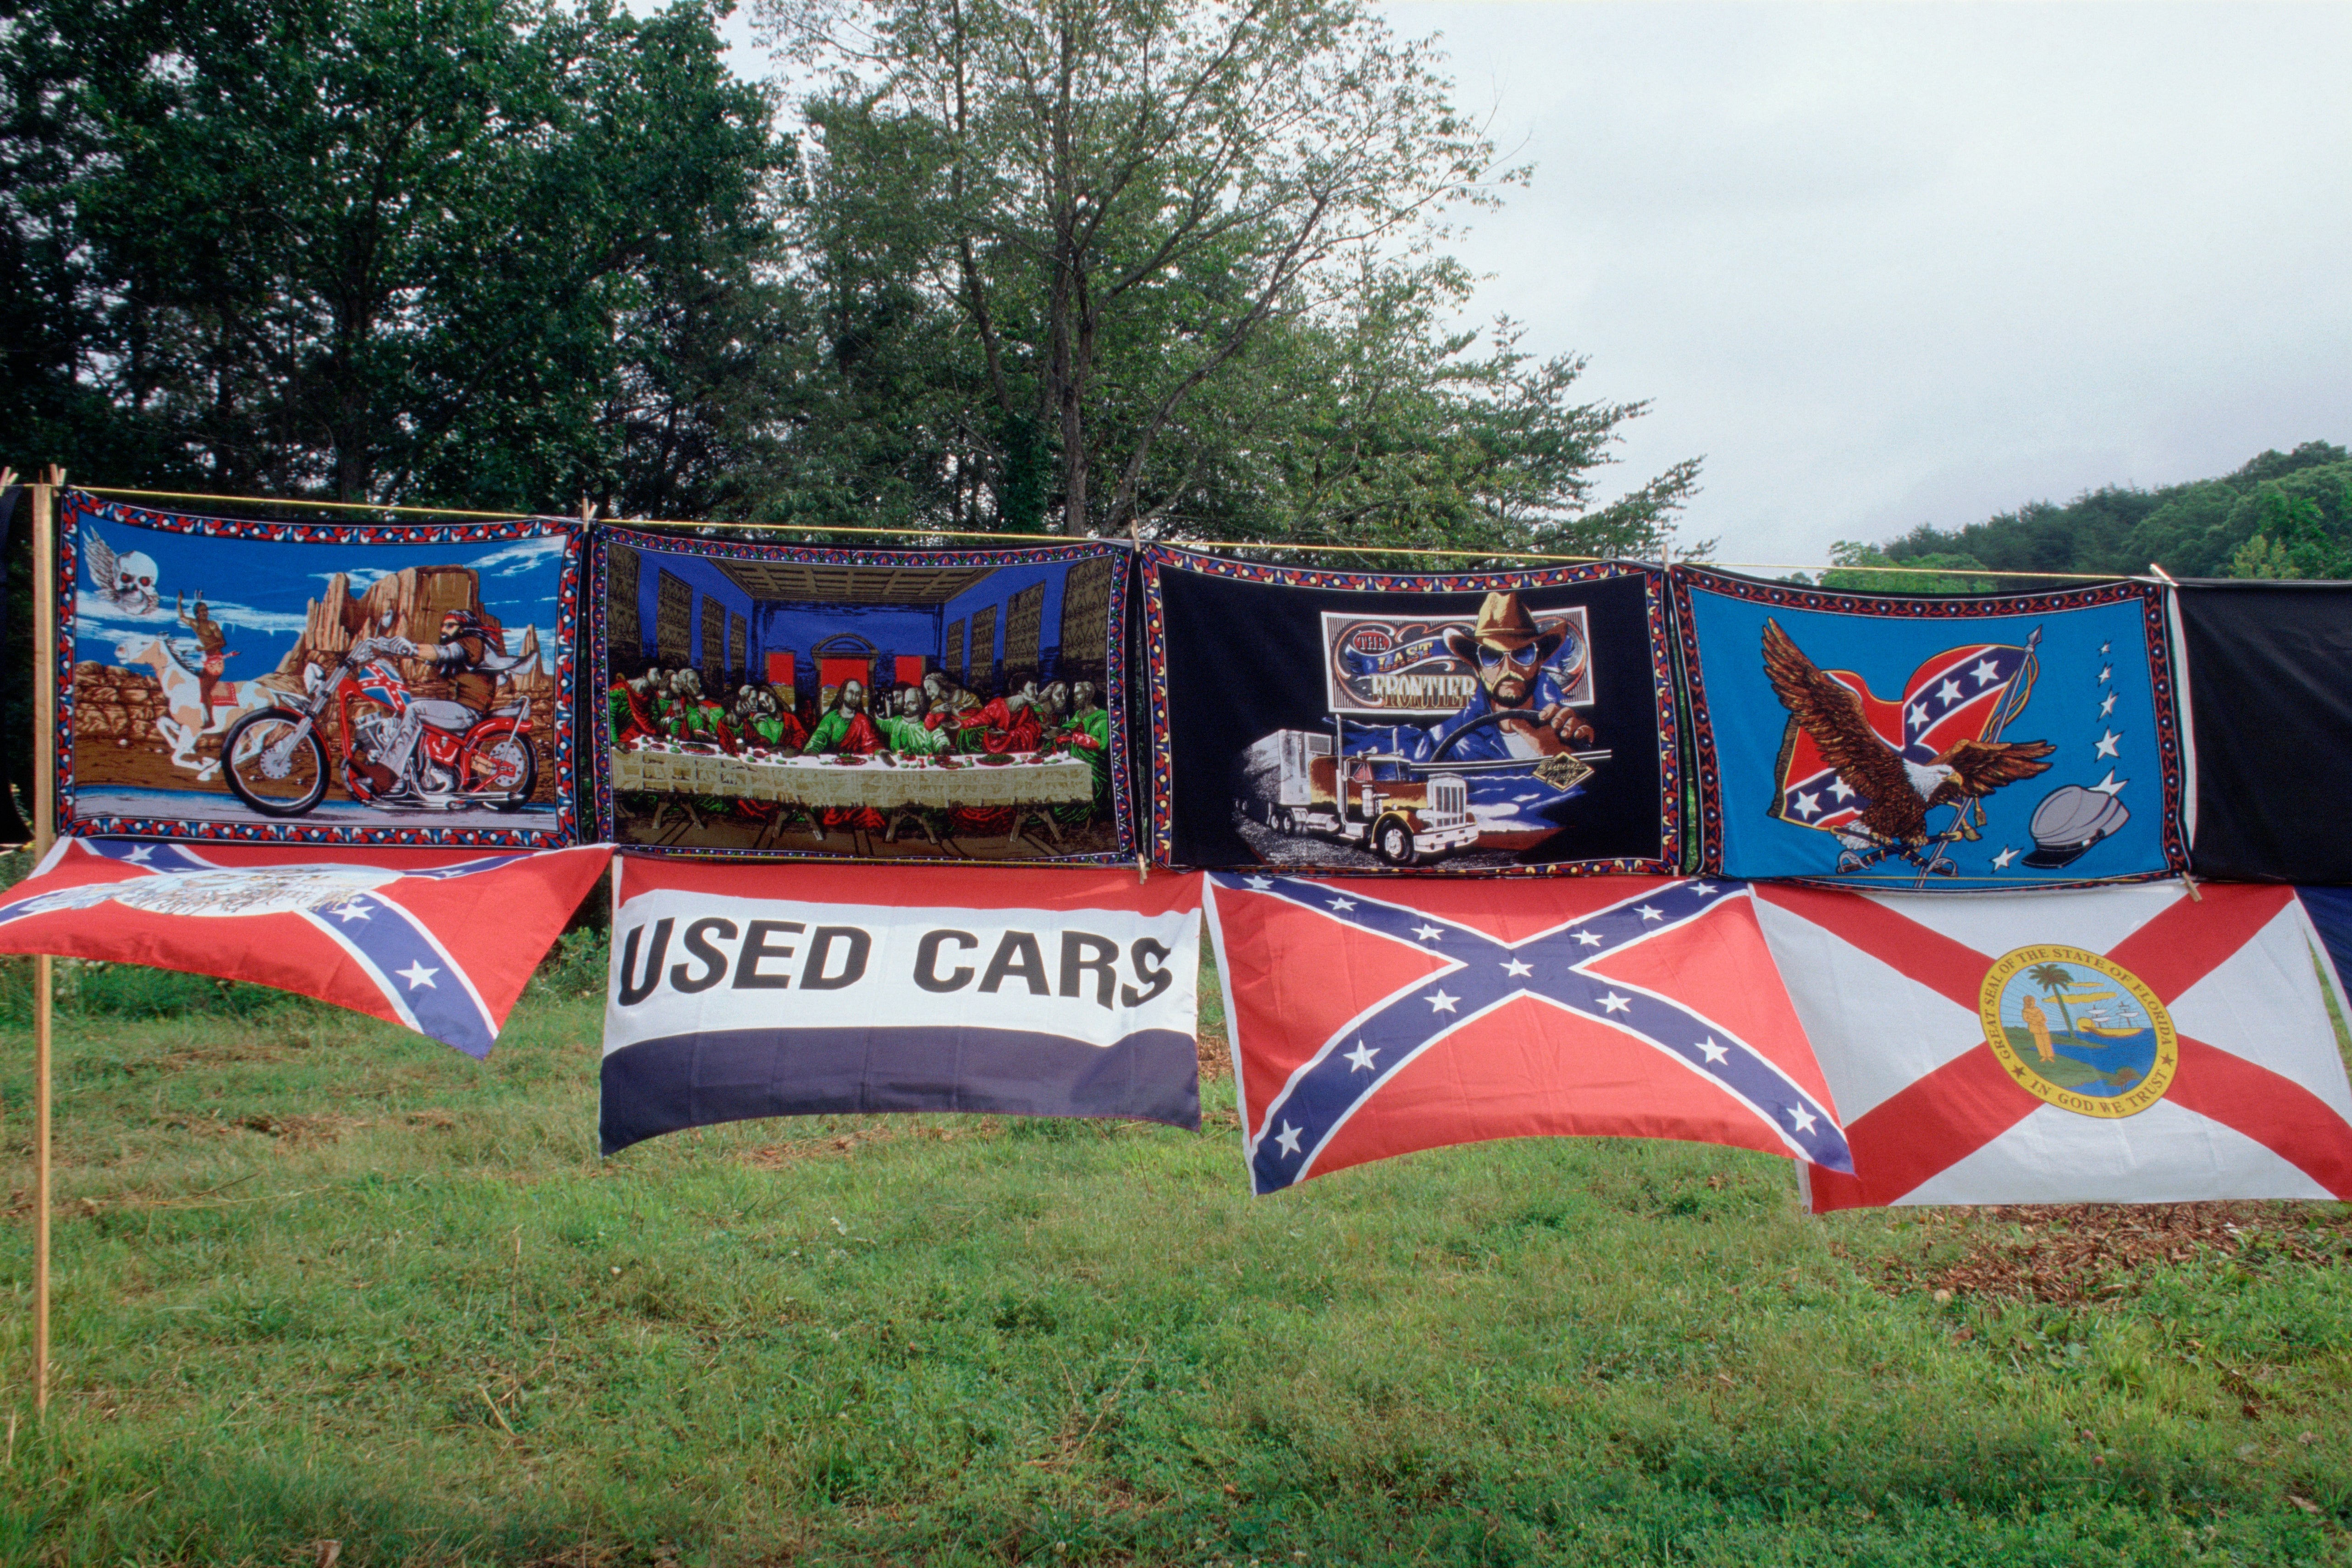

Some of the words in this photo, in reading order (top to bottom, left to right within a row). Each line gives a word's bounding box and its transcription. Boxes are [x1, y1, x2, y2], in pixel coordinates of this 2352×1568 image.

[1357, 635, 1386, 651] THE
[1377, 641, 1434, 672] LAST
[1371, 674, 1478, 708] FRONTIER
[618, 917, 872, 1006] USED
[913, 929, 1172, 1010] CARS
[1999, 957, 2015, 974] OF
[2015, 948, 2049, 963] THE
[2052, 949, 2104, 969] STATE
[2109, 966, 2132, 983] OF
[1984, 975, 2003, 1006] SEAL
[2132, 983, 2173, 1046] FLORIDA
[1984, 1009, 2011, 1060] GREAT
[2029, 1080, 2051, 1096] IN
[2057, 1093, 2093, 1111] GOD
[2099, 1101, 2125, 1114] WE
[2125, 1068, 2167, 1108] TRUST
